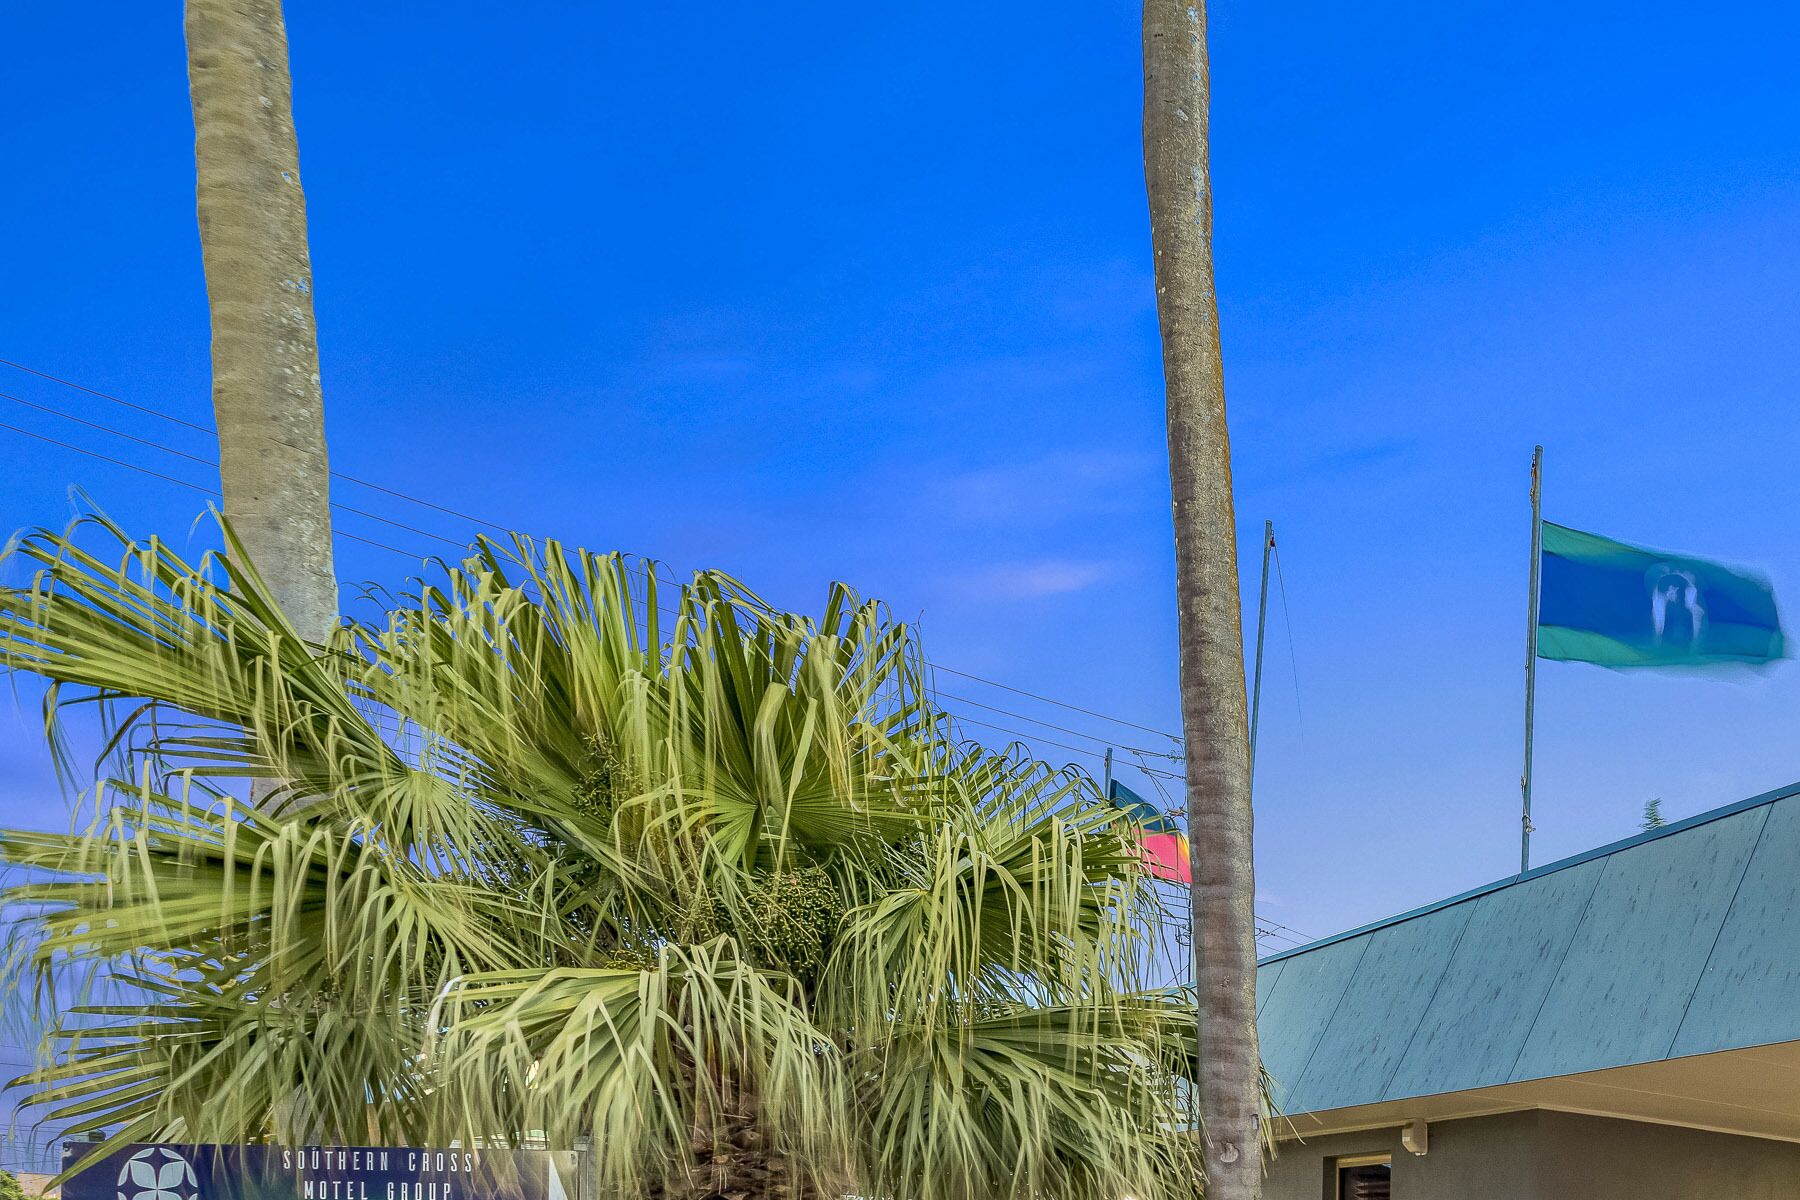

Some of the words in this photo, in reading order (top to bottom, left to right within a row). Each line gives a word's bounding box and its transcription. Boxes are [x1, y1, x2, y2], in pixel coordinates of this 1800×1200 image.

[283, 1150, 388, 1171] SOUTHERN
[408, 1152, 473, 1172] CROSS
[304, 1181, 368, 1200] MOTEL
